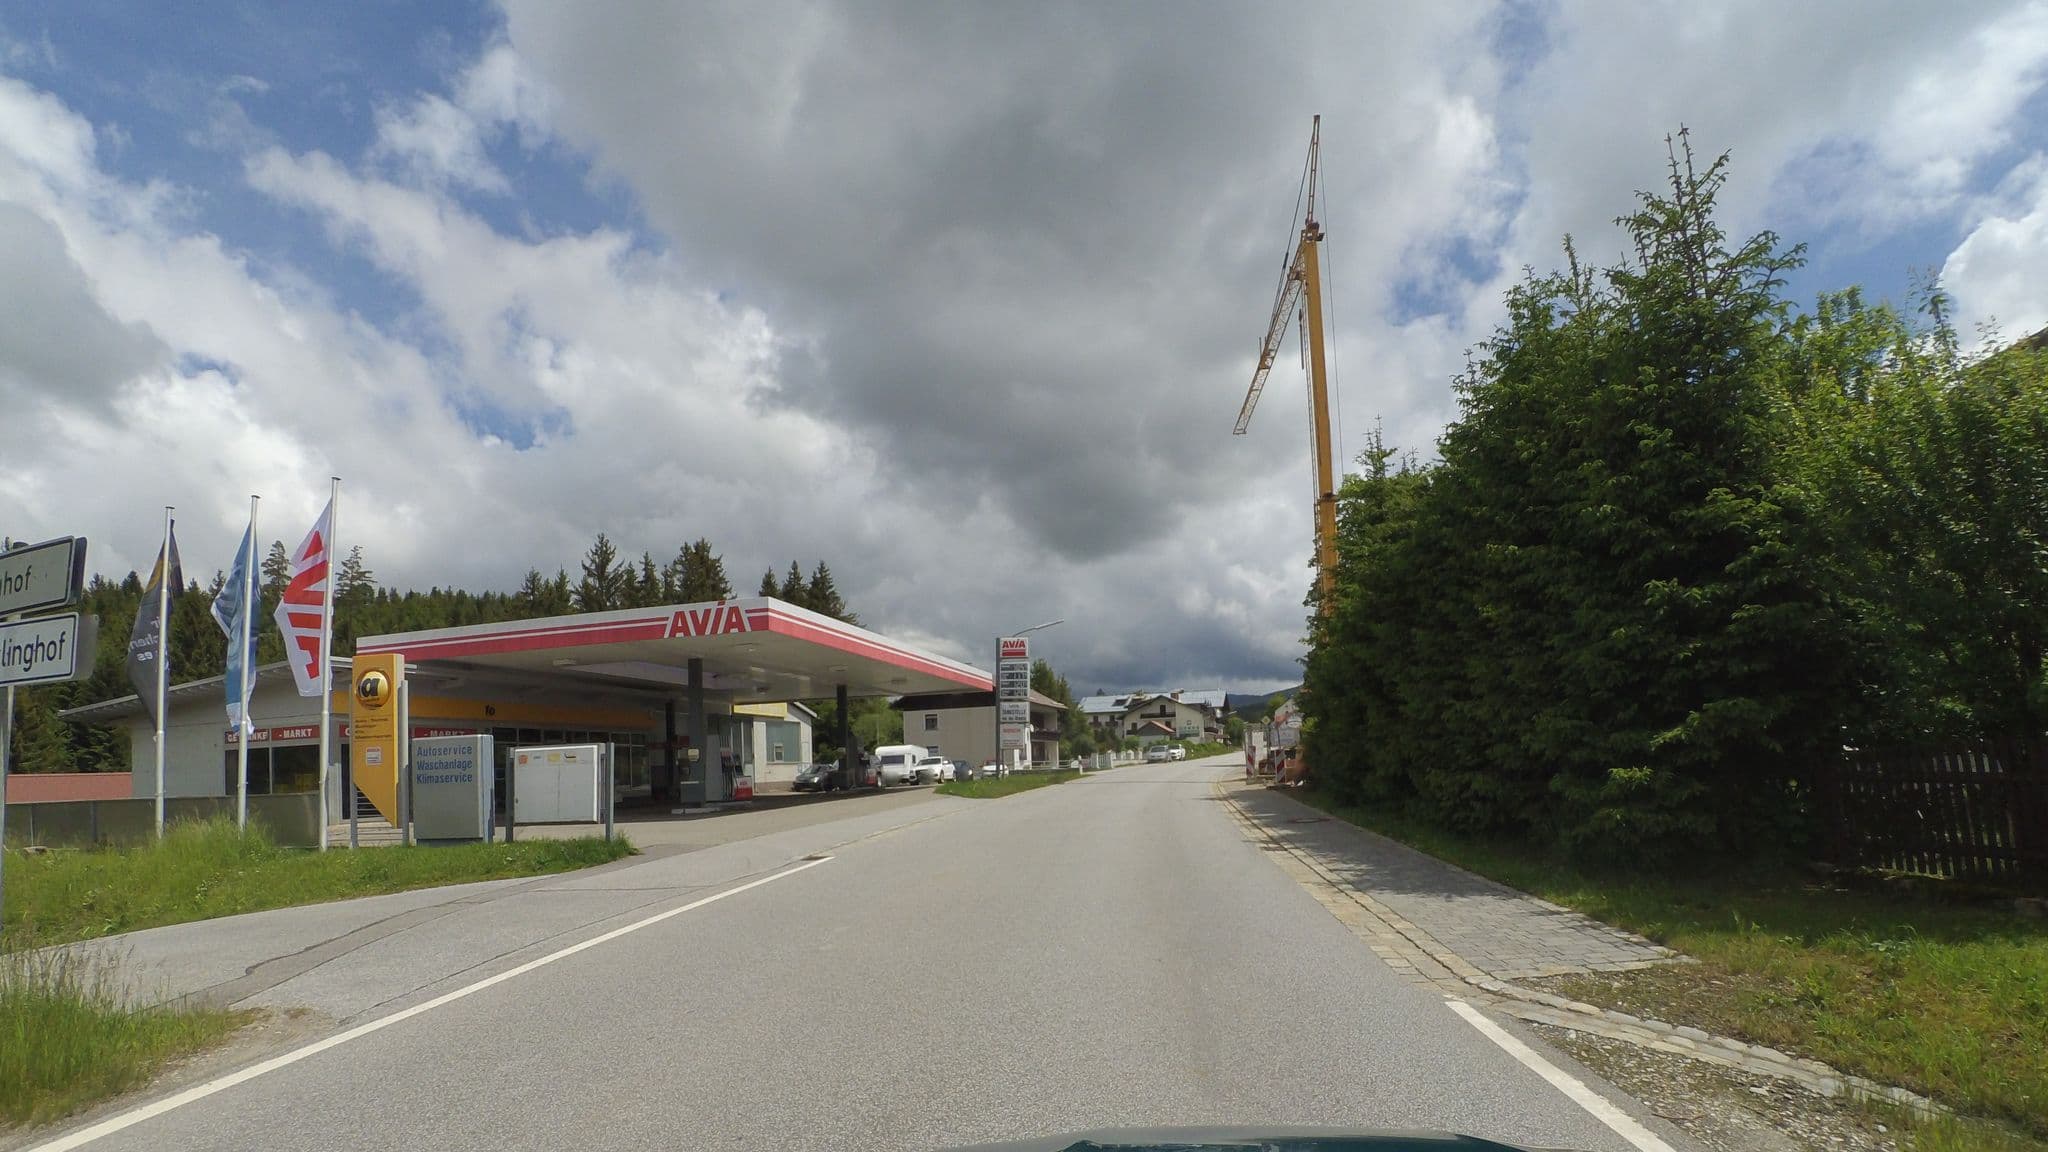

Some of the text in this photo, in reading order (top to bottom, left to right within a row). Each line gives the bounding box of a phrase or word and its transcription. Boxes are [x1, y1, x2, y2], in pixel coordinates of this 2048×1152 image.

[0, 565, 32, 596] hof
[669, 600, 746, 638] AVIA
[1002, 638, 1026, 648] AVIA
[0, 631, 66, 672] linghof
[284, 728, 313, 739] MARKT
[416, 746, 473, 757] Autoservice
[416, 759, 473, 772] Waschanlage
[416, 773, 473, 785] Klimaservice
